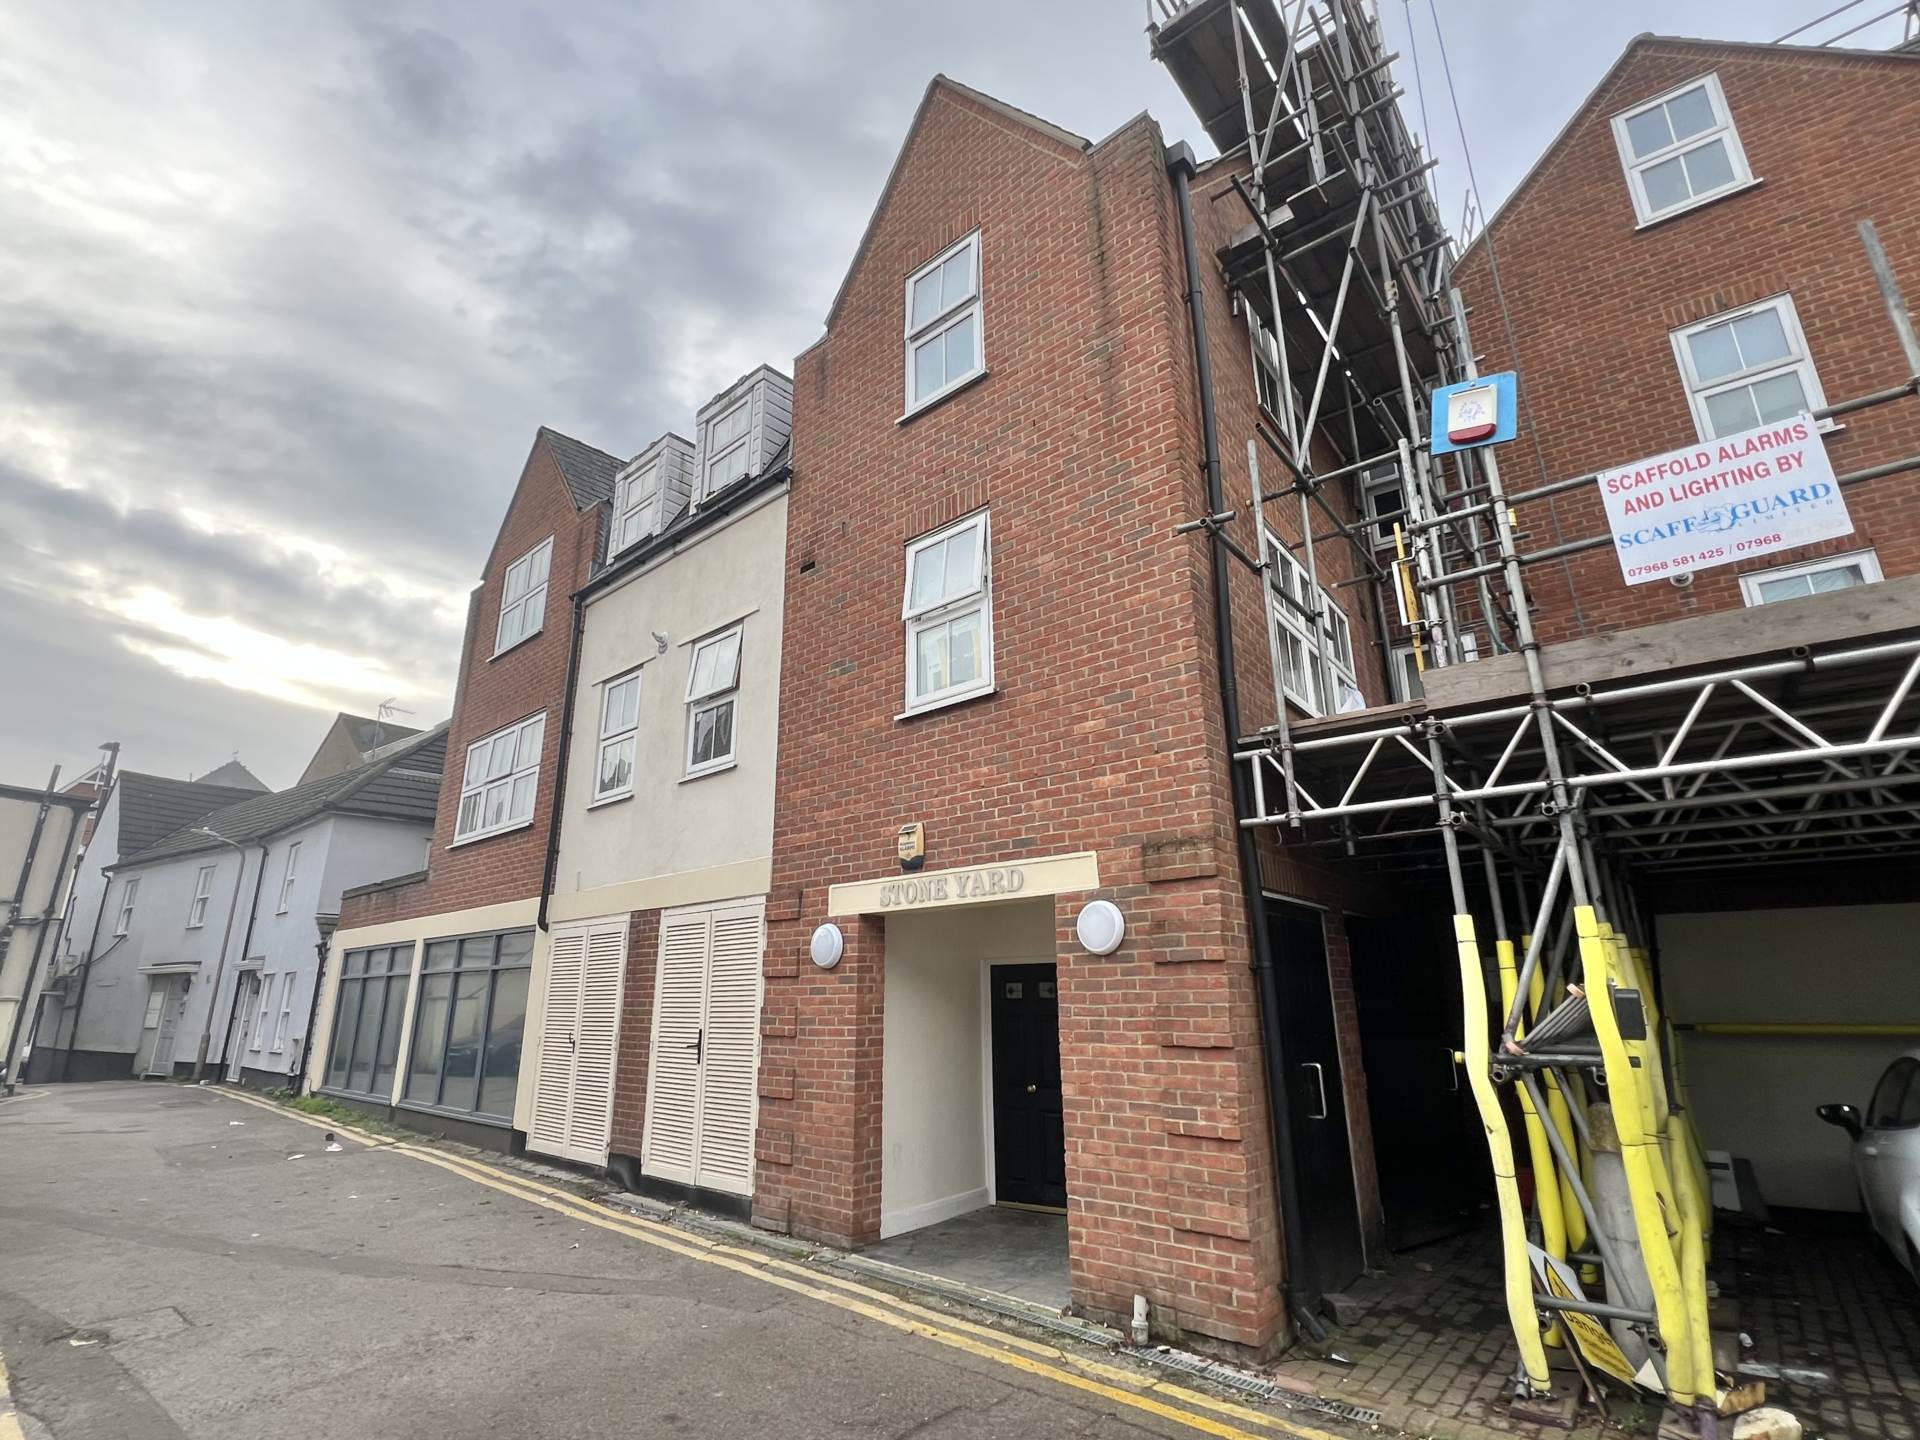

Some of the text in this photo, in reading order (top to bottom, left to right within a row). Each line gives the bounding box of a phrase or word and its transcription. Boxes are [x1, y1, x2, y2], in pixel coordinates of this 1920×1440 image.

[1607, 423, 1809, 494] SCAFFOLD ALARMS
[1624, 451, 1804, 516] AND LIGHTING BY
[1730, 482, 1832, 520] GUARD
[1628, 561, 1669, 578] 07968
[1672, 554, 1696, 567] 581
[1698, 547, 1724, 560] 425
[1736, 533, 1782, 552] 07968
[880, 867, 1025, 907] STONE YARD
